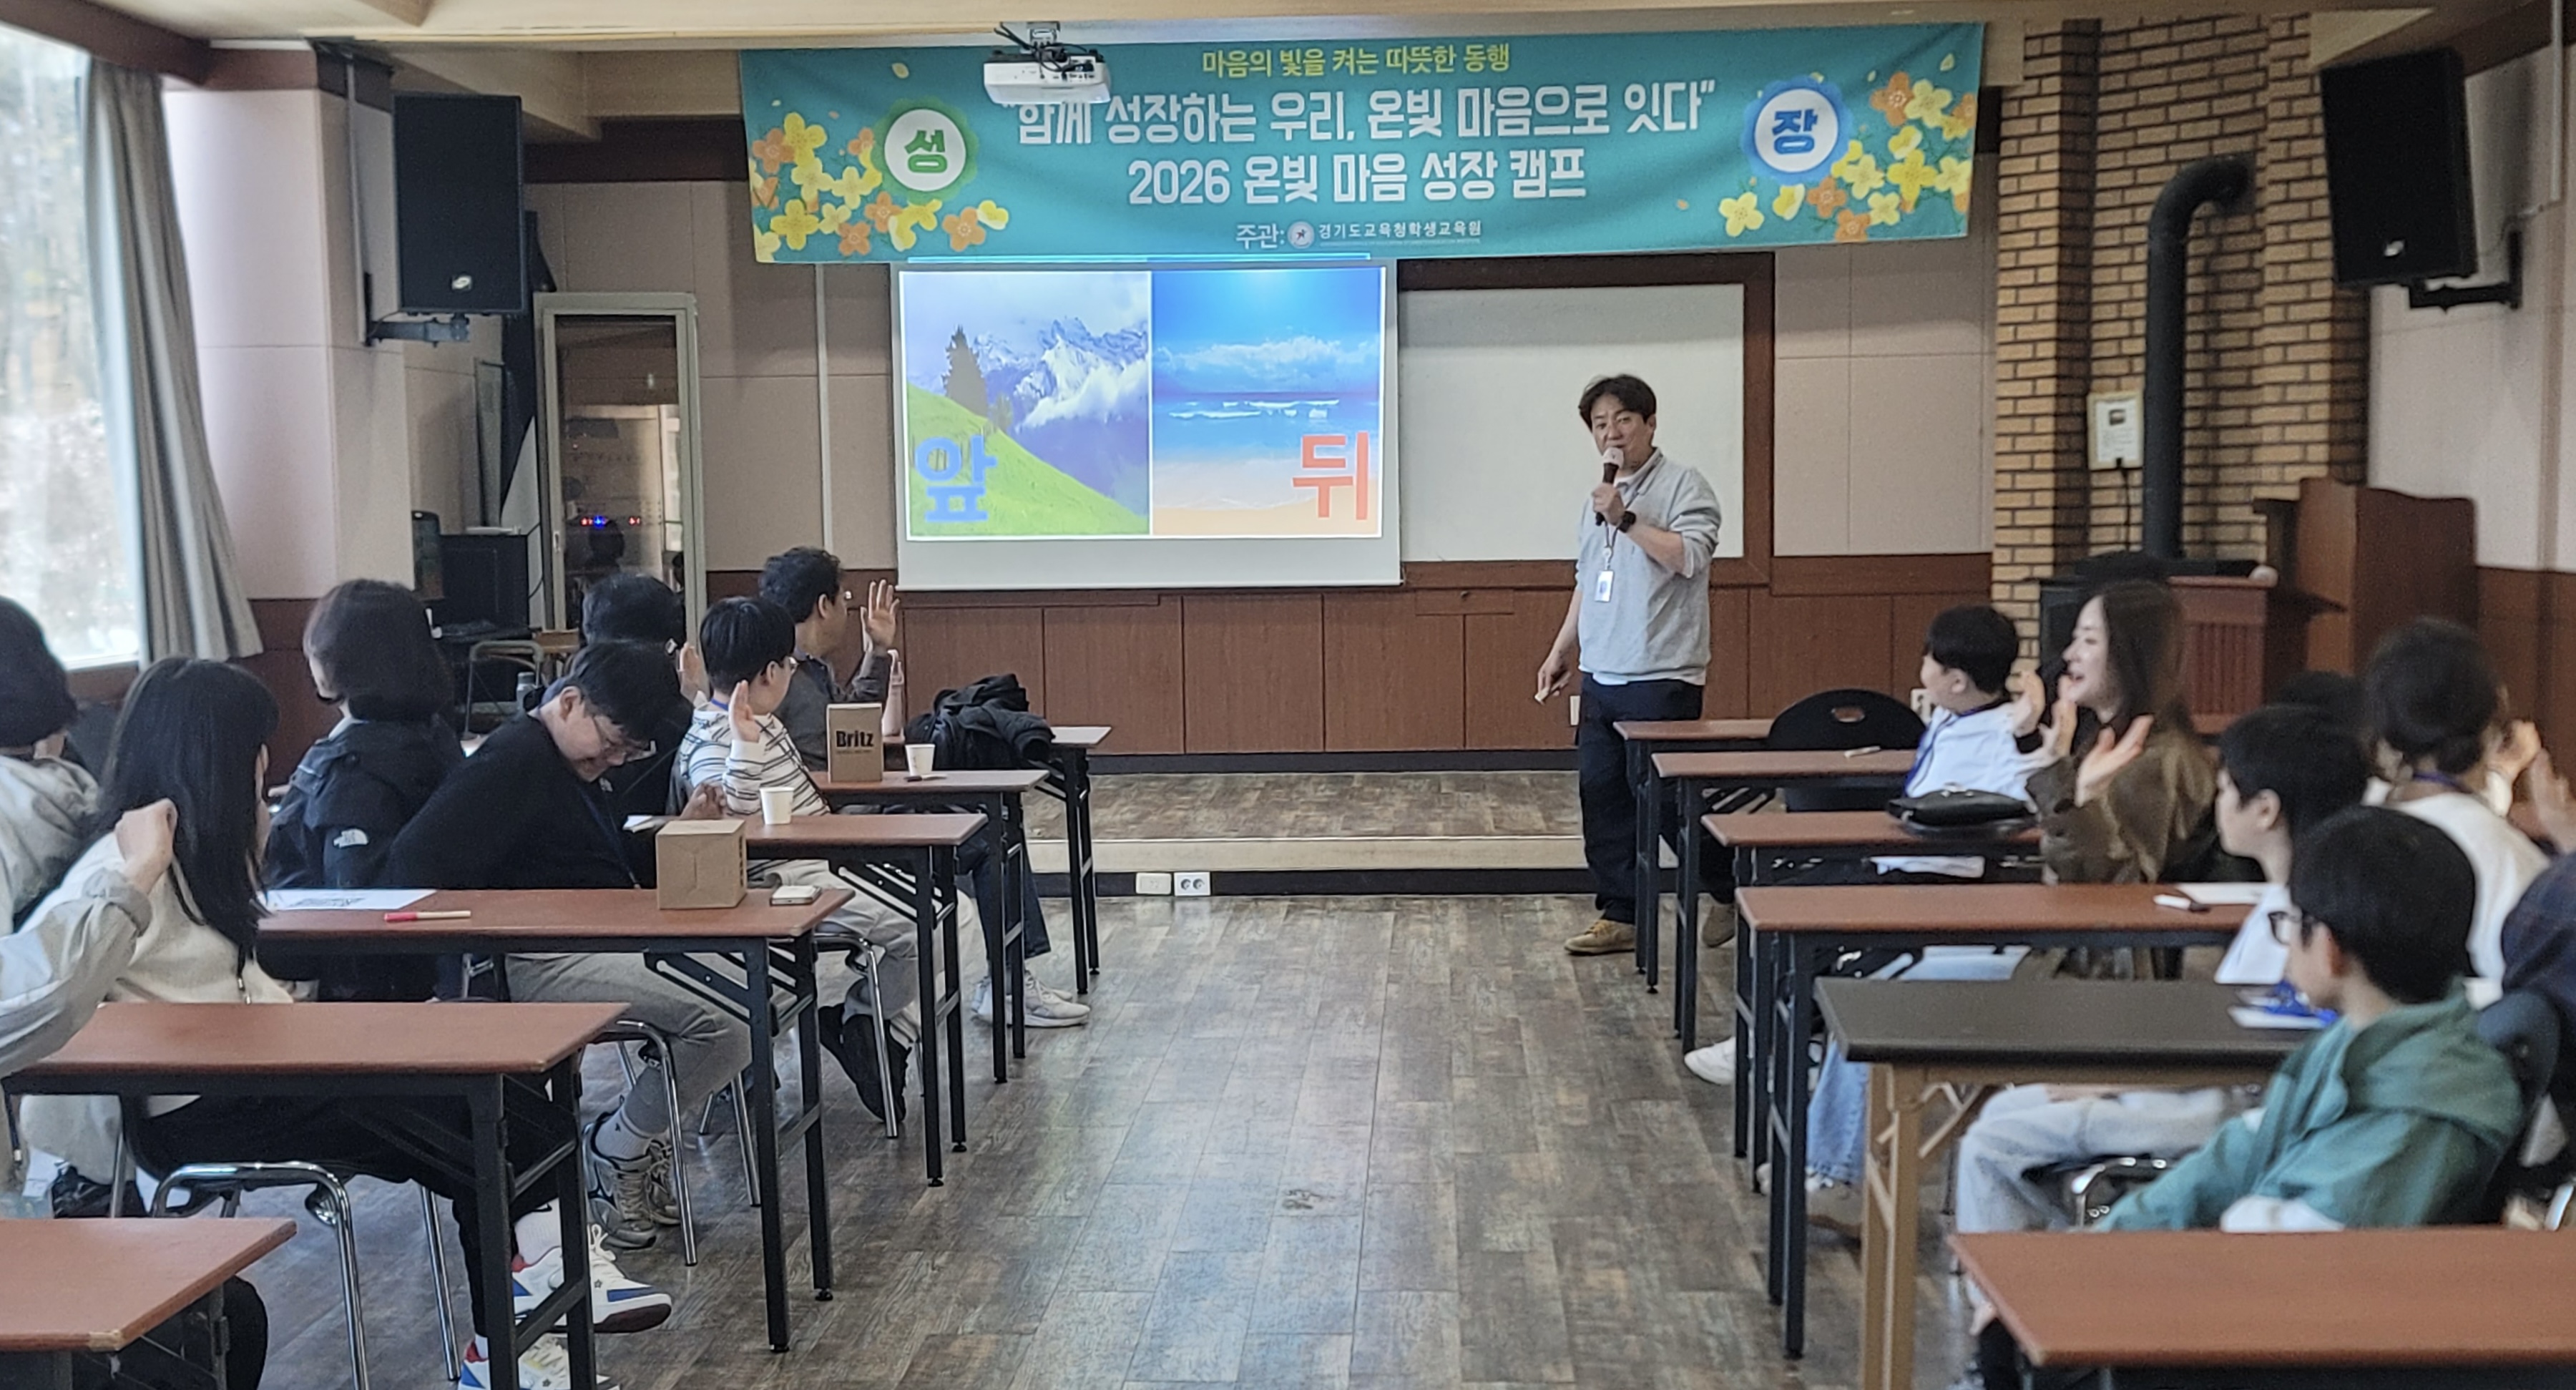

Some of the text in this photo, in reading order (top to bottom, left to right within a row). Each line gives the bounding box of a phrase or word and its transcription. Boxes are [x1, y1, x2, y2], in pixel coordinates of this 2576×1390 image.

[1203, 42, 1510, 78] 마음의 빛을 켜는 따뜻한 동행
[1105, 92, 1257, 144] 성장하는
[1270, 90, 1356, 141] 우리,
[1368, 88, 1442, 140] 온빛
[1457, 84, 1610, 138] 마음으로
[1624, 79, 1715, 134] 잇다"
[1772, 108, 1818, 155] 장
[904, 129, 948, 173] 성
[1128, 148, 1586, 205] 2026 온빛 마음 성장 캠프
[1235, 223, 1285, 250] 주관:
[914, 434, 998, 522] 앞
[1291, 431, 1369, 522] 뒤
[836, 730, 874, 748] Britz
